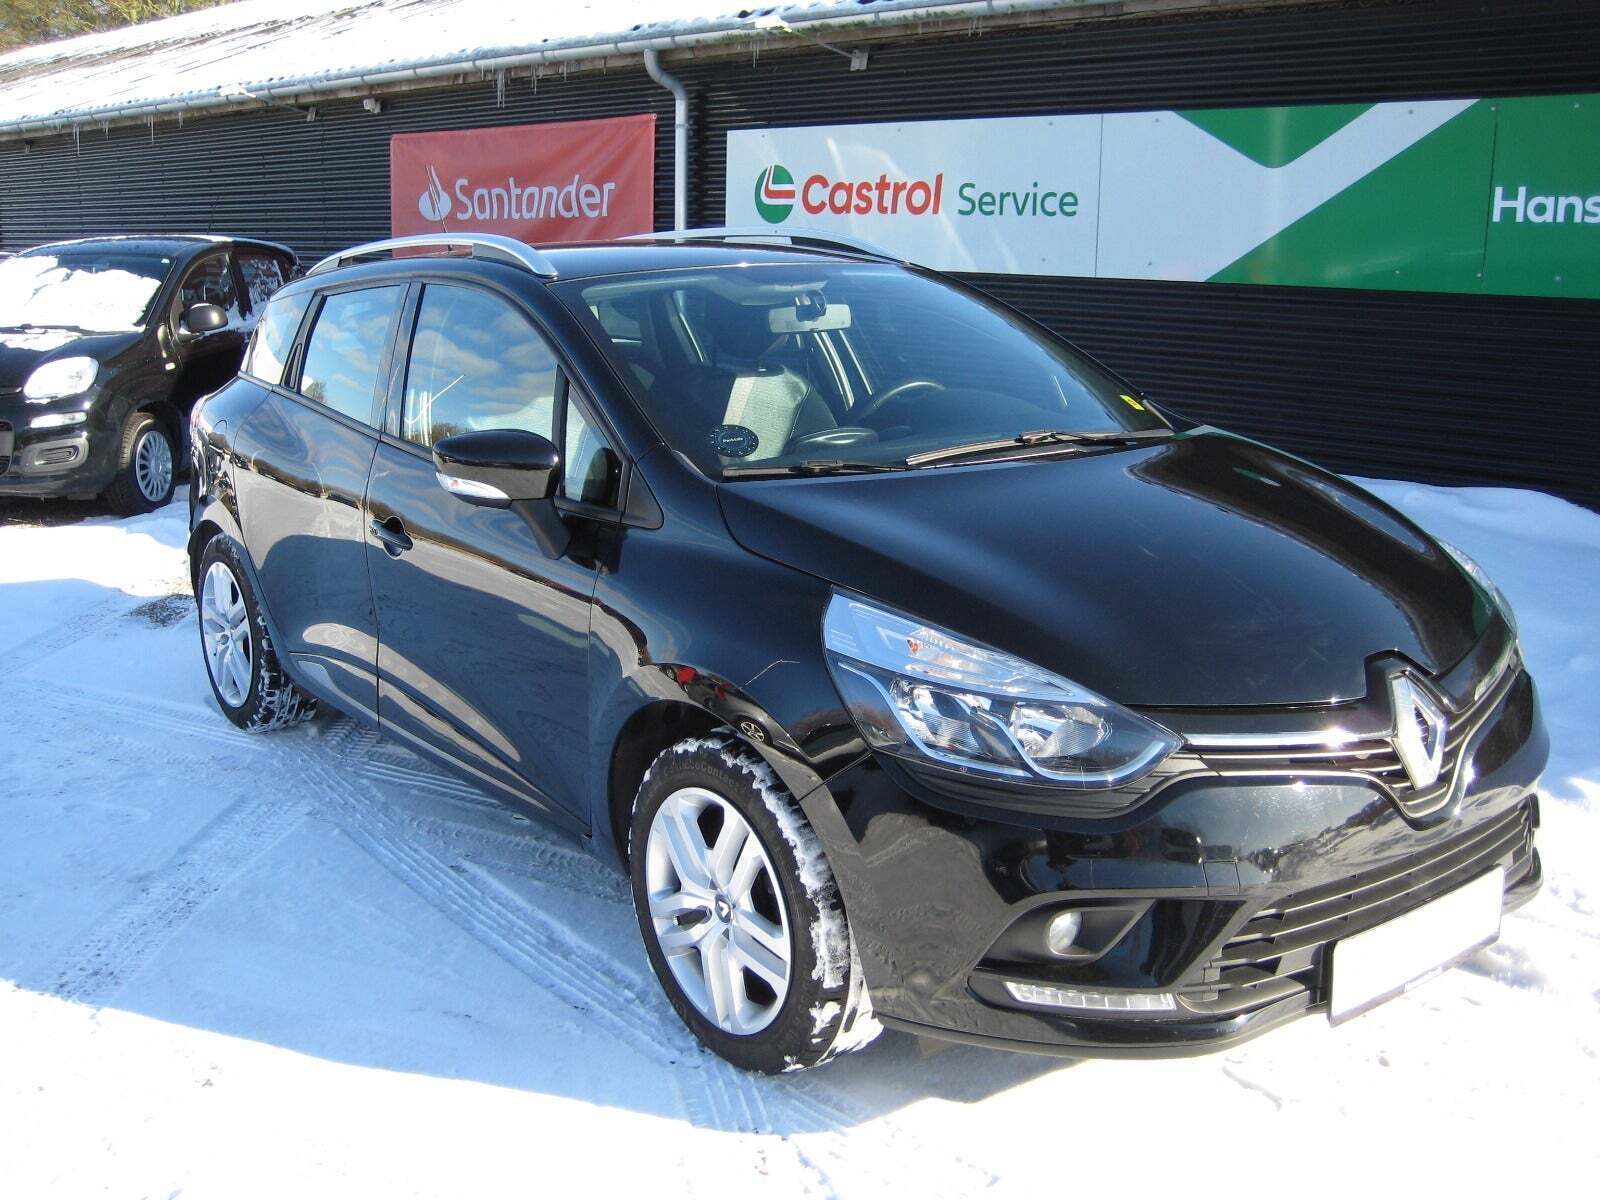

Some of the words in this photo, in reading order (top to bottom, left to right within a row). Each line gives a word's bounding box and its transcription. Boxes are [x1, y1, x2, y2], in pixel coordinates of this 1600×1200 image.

[455, 174, 616, 220] Santander
[801, 172, 943, 216] Castrol
[957, 181, 1079, 217] Service
[1492, 186, 1600, 223] Hans
